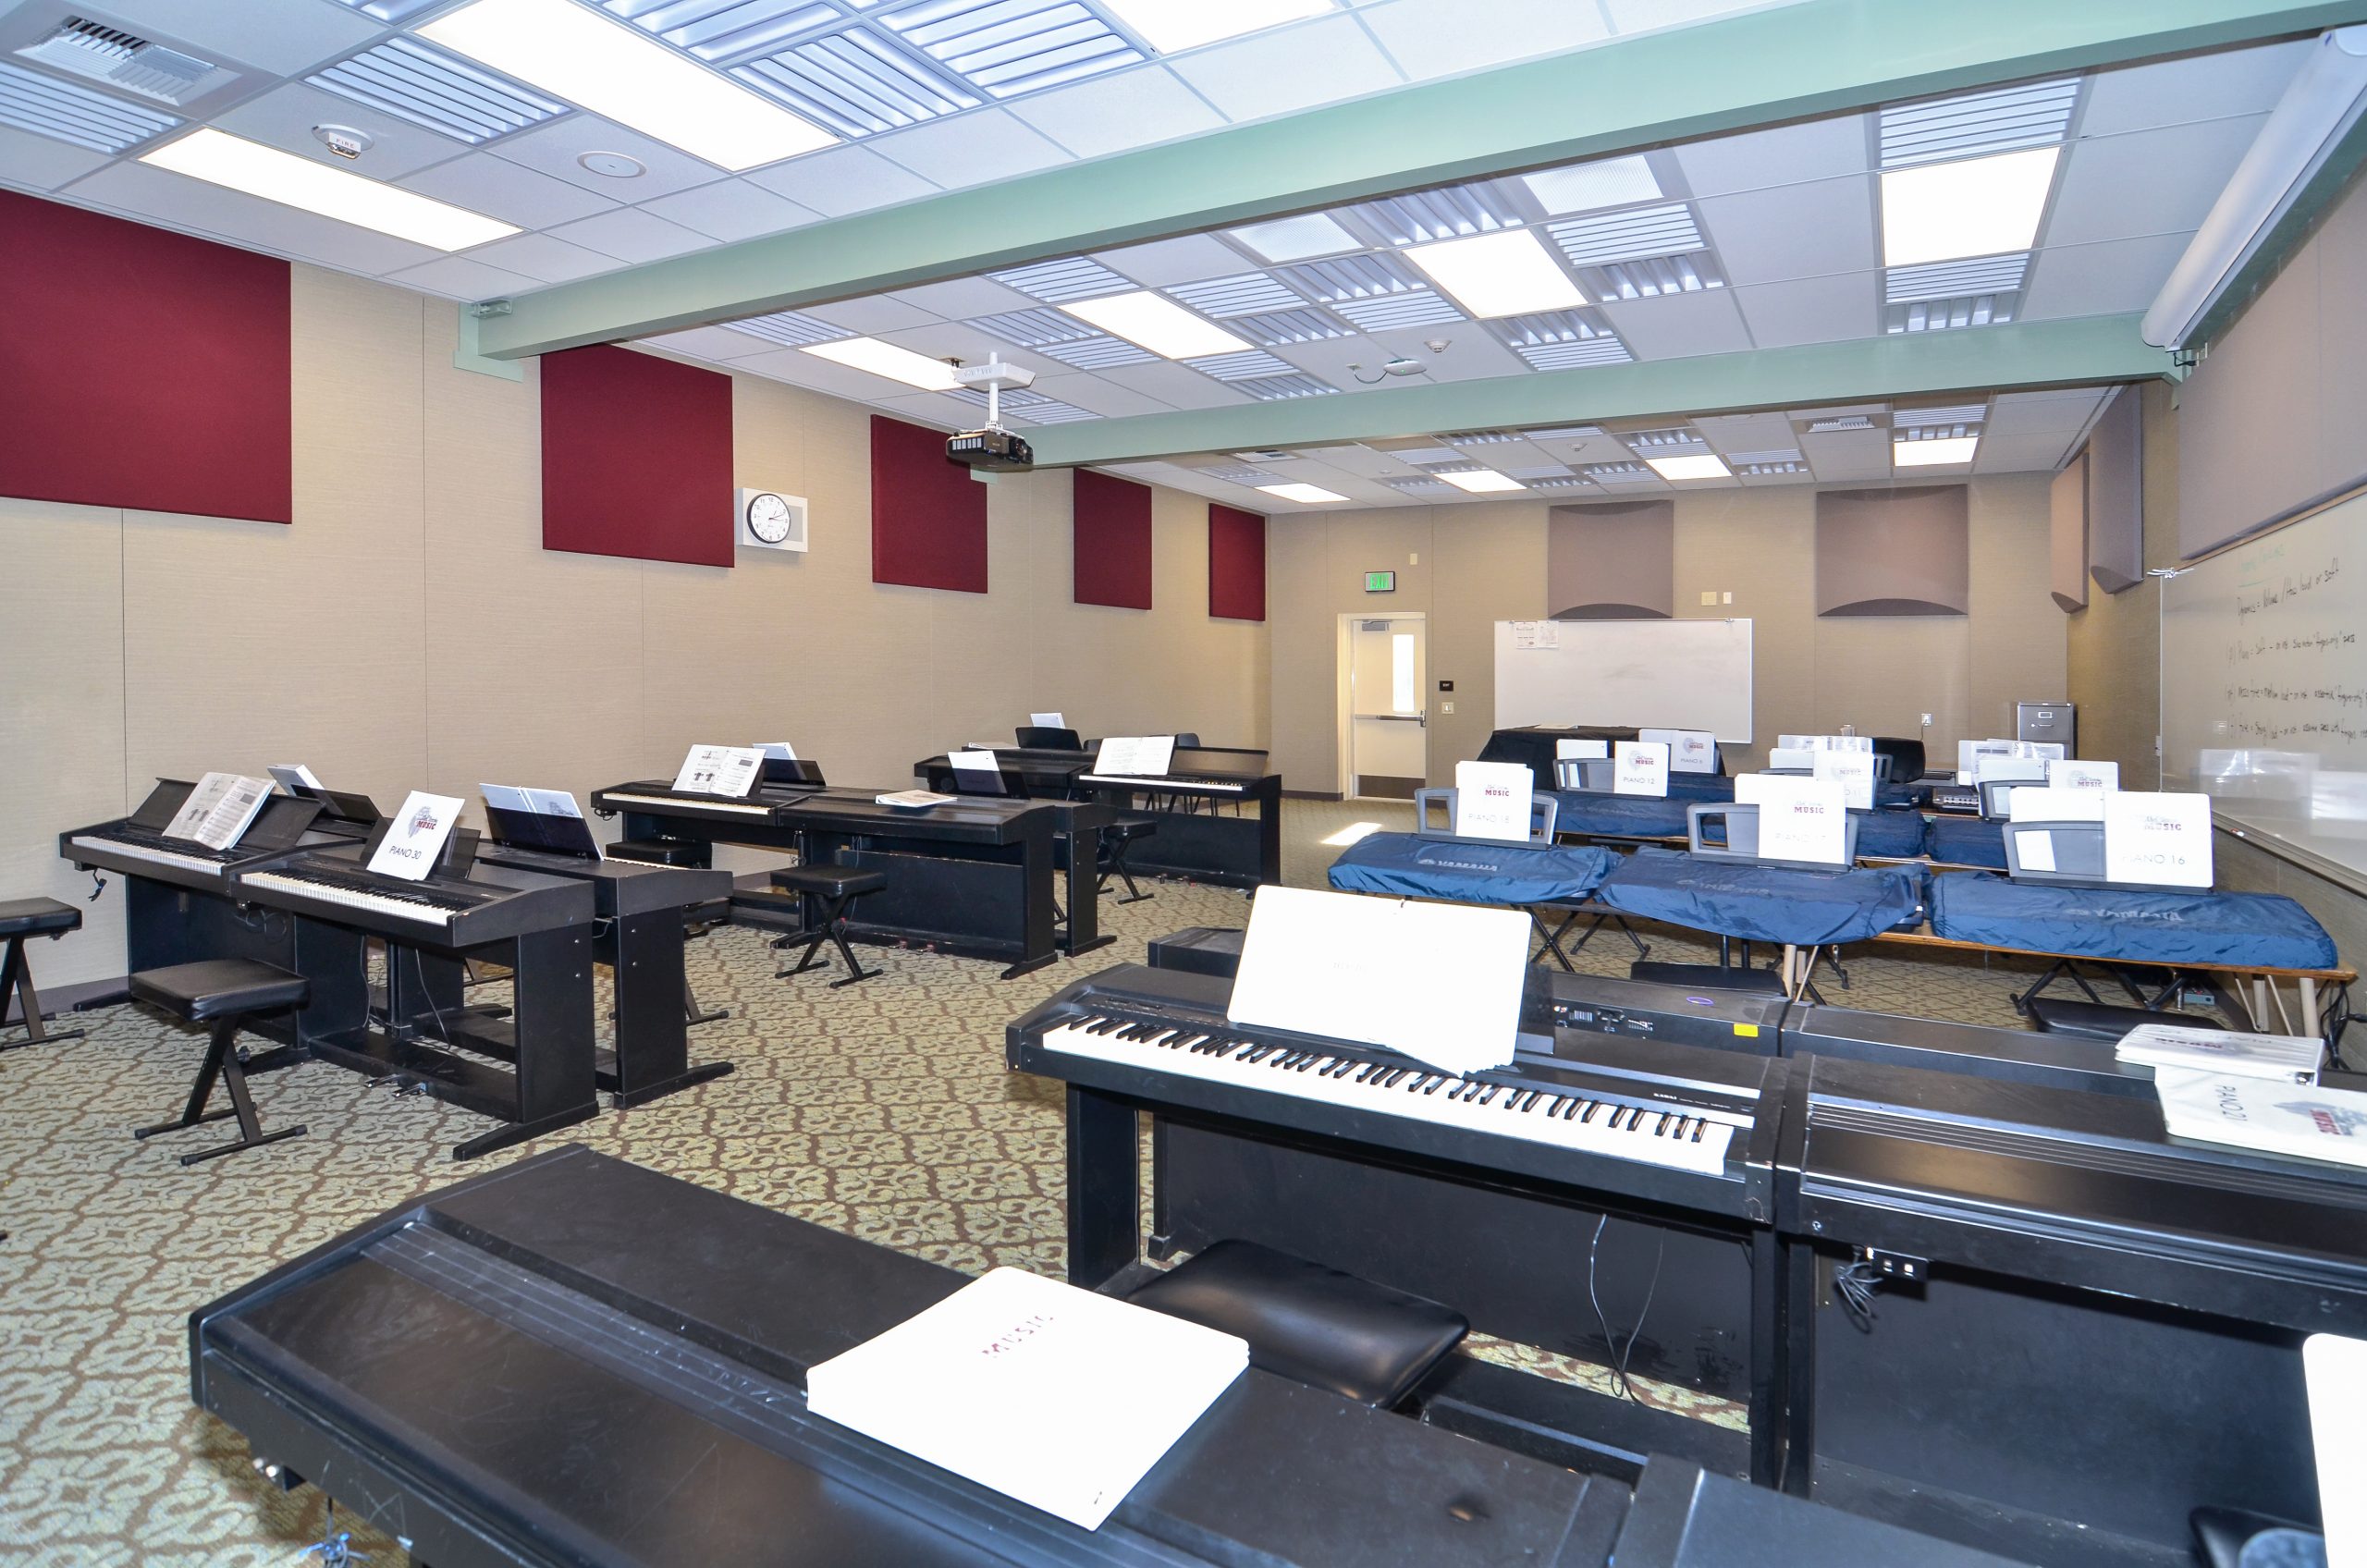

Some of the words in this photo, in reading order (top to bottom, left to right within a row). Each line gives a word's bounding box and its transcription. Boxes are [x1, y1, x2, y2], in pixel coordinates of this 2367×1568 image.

[336, 138, 355, 148] FIRE
[1369, 574, 1390, 590] EXIT
[416, 820, 436, 830] MUSIC
[389, 845, 412, 858] PIANO
[411, 850, 422, 860] 30
[2171, 854, 2186, 865] 16
